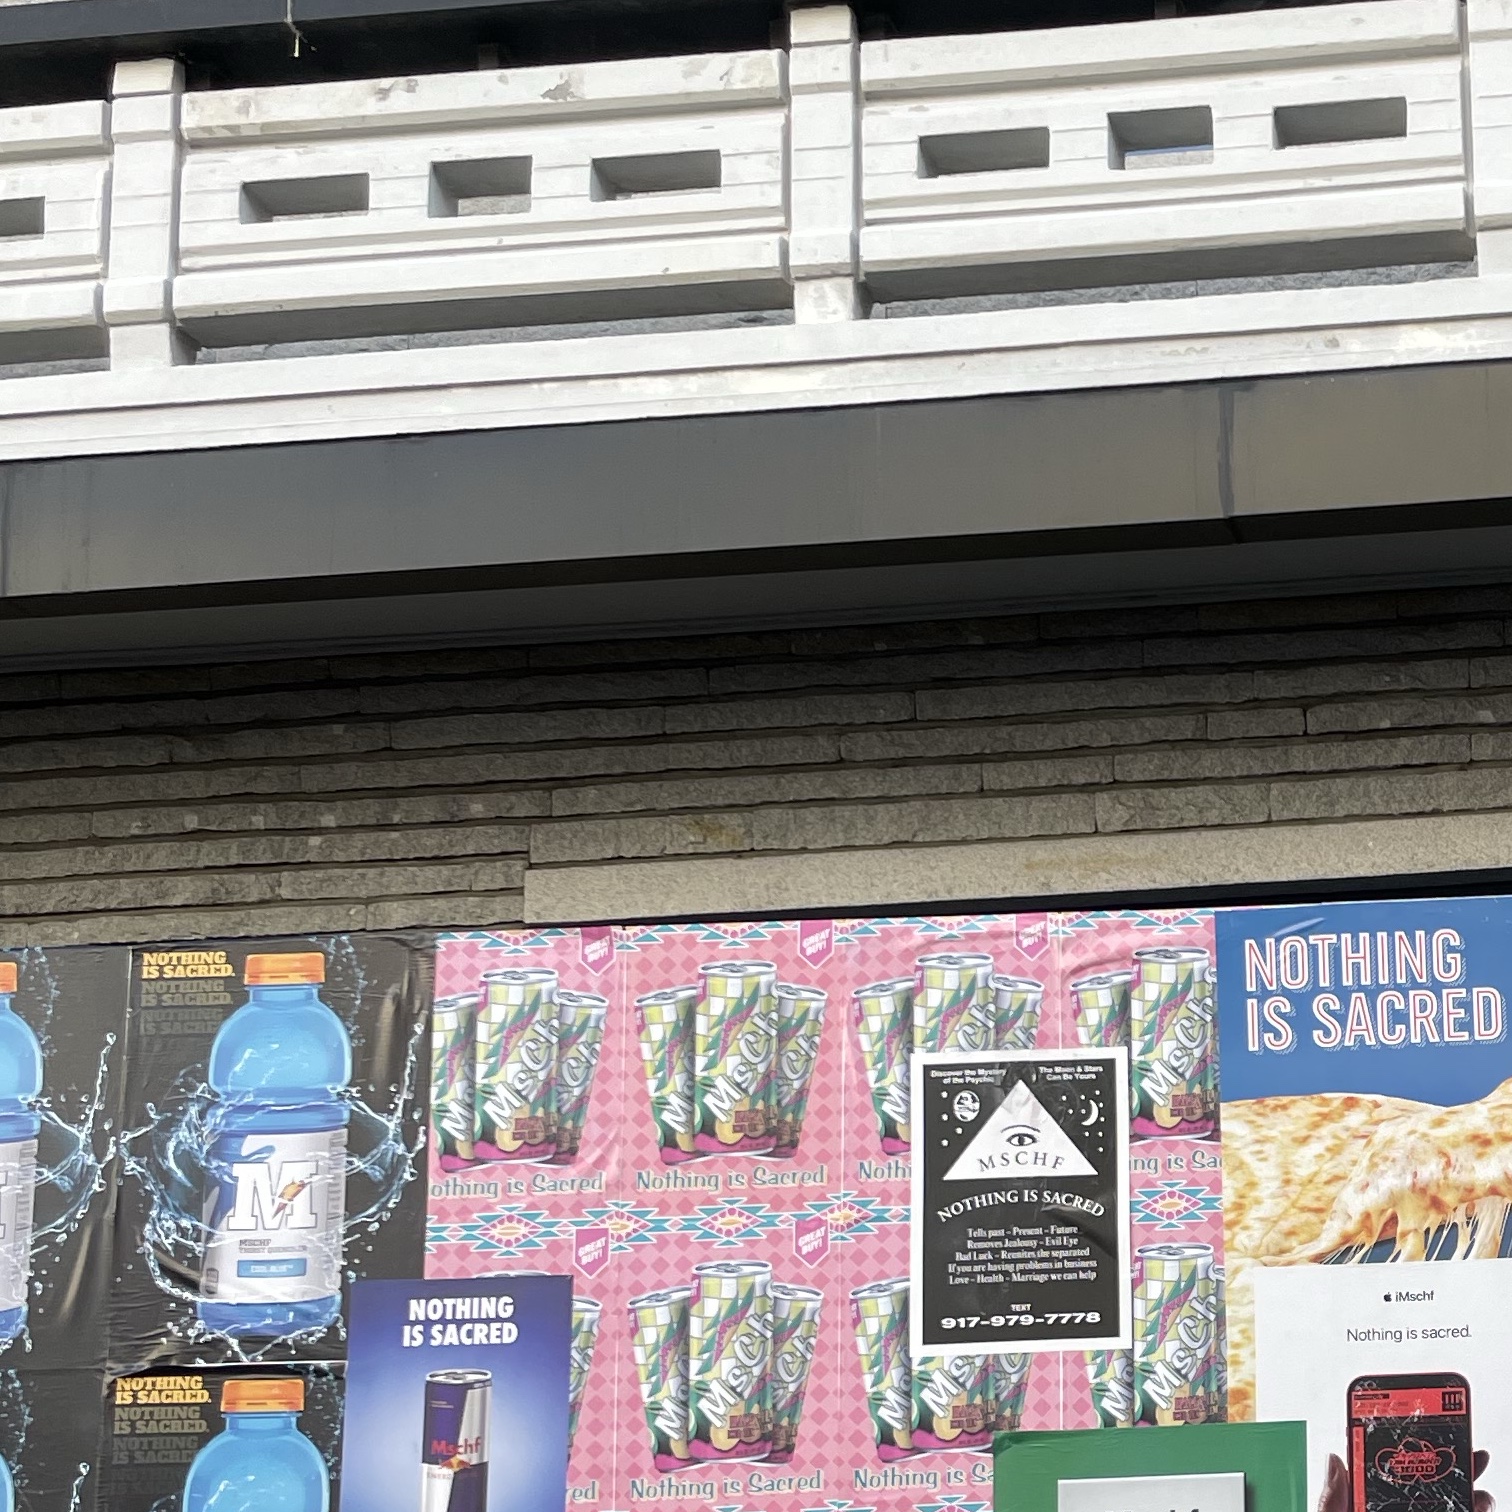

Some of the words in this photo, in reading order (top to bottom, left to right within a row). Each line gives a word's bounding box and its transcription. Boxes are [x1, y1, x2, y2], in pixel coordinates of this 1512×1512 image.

[142, 951, 227, 966] NOTHING
[1244, 928, 1465, 992] NOTHING
[142, 966, 160, 979] IS
[163, 964, 236, 979] SACRED.
[1247, 992, 1296, 1053] IS
[1312, 987, 1507, 1050] SACRED
[977, 1151, 1065, 1172] MSCHF
[636, 1168, 720, 1192] Nothing
[728, 1170, 745, 1187] is
[753, 1164, 825, 1186] Sacred
[227, 1160, 319, 1231] M
[937, 1189, 1019, 1222] NOTHING
[1023, 1190, 1038, 1202] IS
[1042, 1190, 1105, 1217] SACRED
[967, 1228, 986, 1238] Tells
[988, 1230, 1005, 1239] past
[1012, 1227, 1043, 1236] Present
[1050, 1225, 1078, 1235] Future
[967, 1239, 1003, 1249] Removes
[1004, 1238, 1038, 1249] Jealousy
[1045, 1236, 1062, 1246] Evil
[1064, 1236, 1079, 1247] Eye
[955, 1252, 972, 1261] Bad
[973, 1251, 993, 1261] Luck
[1001, 1249, 1036, 1259] Reunites
[1037, 1248, 1050, 1258] the
[1051, 1247, 1090, 1259] separated
[948, 1263, 956, 1273] If
[956, 1264, 972, 1275] you
[973, 1264, 986, 1273] are
[987, 1262, 1015, 1274] having
[1016, 1260, 1053, 1272] problems
[1055, 1260, 1063, 1269] in
[1064, 1259, 1097, 1269] business
[949, 1275, 969, 1284] Love
[976, 1273, 1004, 1283] Health
[1011, 1272, 1049, 1283] Marriage
[1050, 1272, 1061, 1281] we
[1062, 1271, 1077, 1280] can
[1078, 1270, 1097, 1281] help
[1395, 1289, 1434, 1303] iMschf
[409, 1296, 514, 1321] NOTHING
[941, 1312, 1101, 1329] 917-979-7778
[402, 1325, 424, 1347] IS
[430, 1322, 518, 1346] SACRED
[1346, 1326, 1402, 1344] Nothing
[1405, 1326, 1418, 1340] is
[1421, 1325, 1472, 1340] sacred.
[116, 1375, 203, 1390] NOTHING
[115, 1391, 134, 1405] IS
[137, 1389, 212, 1404] SACRED.
[431, 1436, 481, 1455] Mschf
[630, 1478, 715, 1500] Nothing
[724, 1477, 741, 1494] is
[748, 1470, 821, 1492] Sacred
